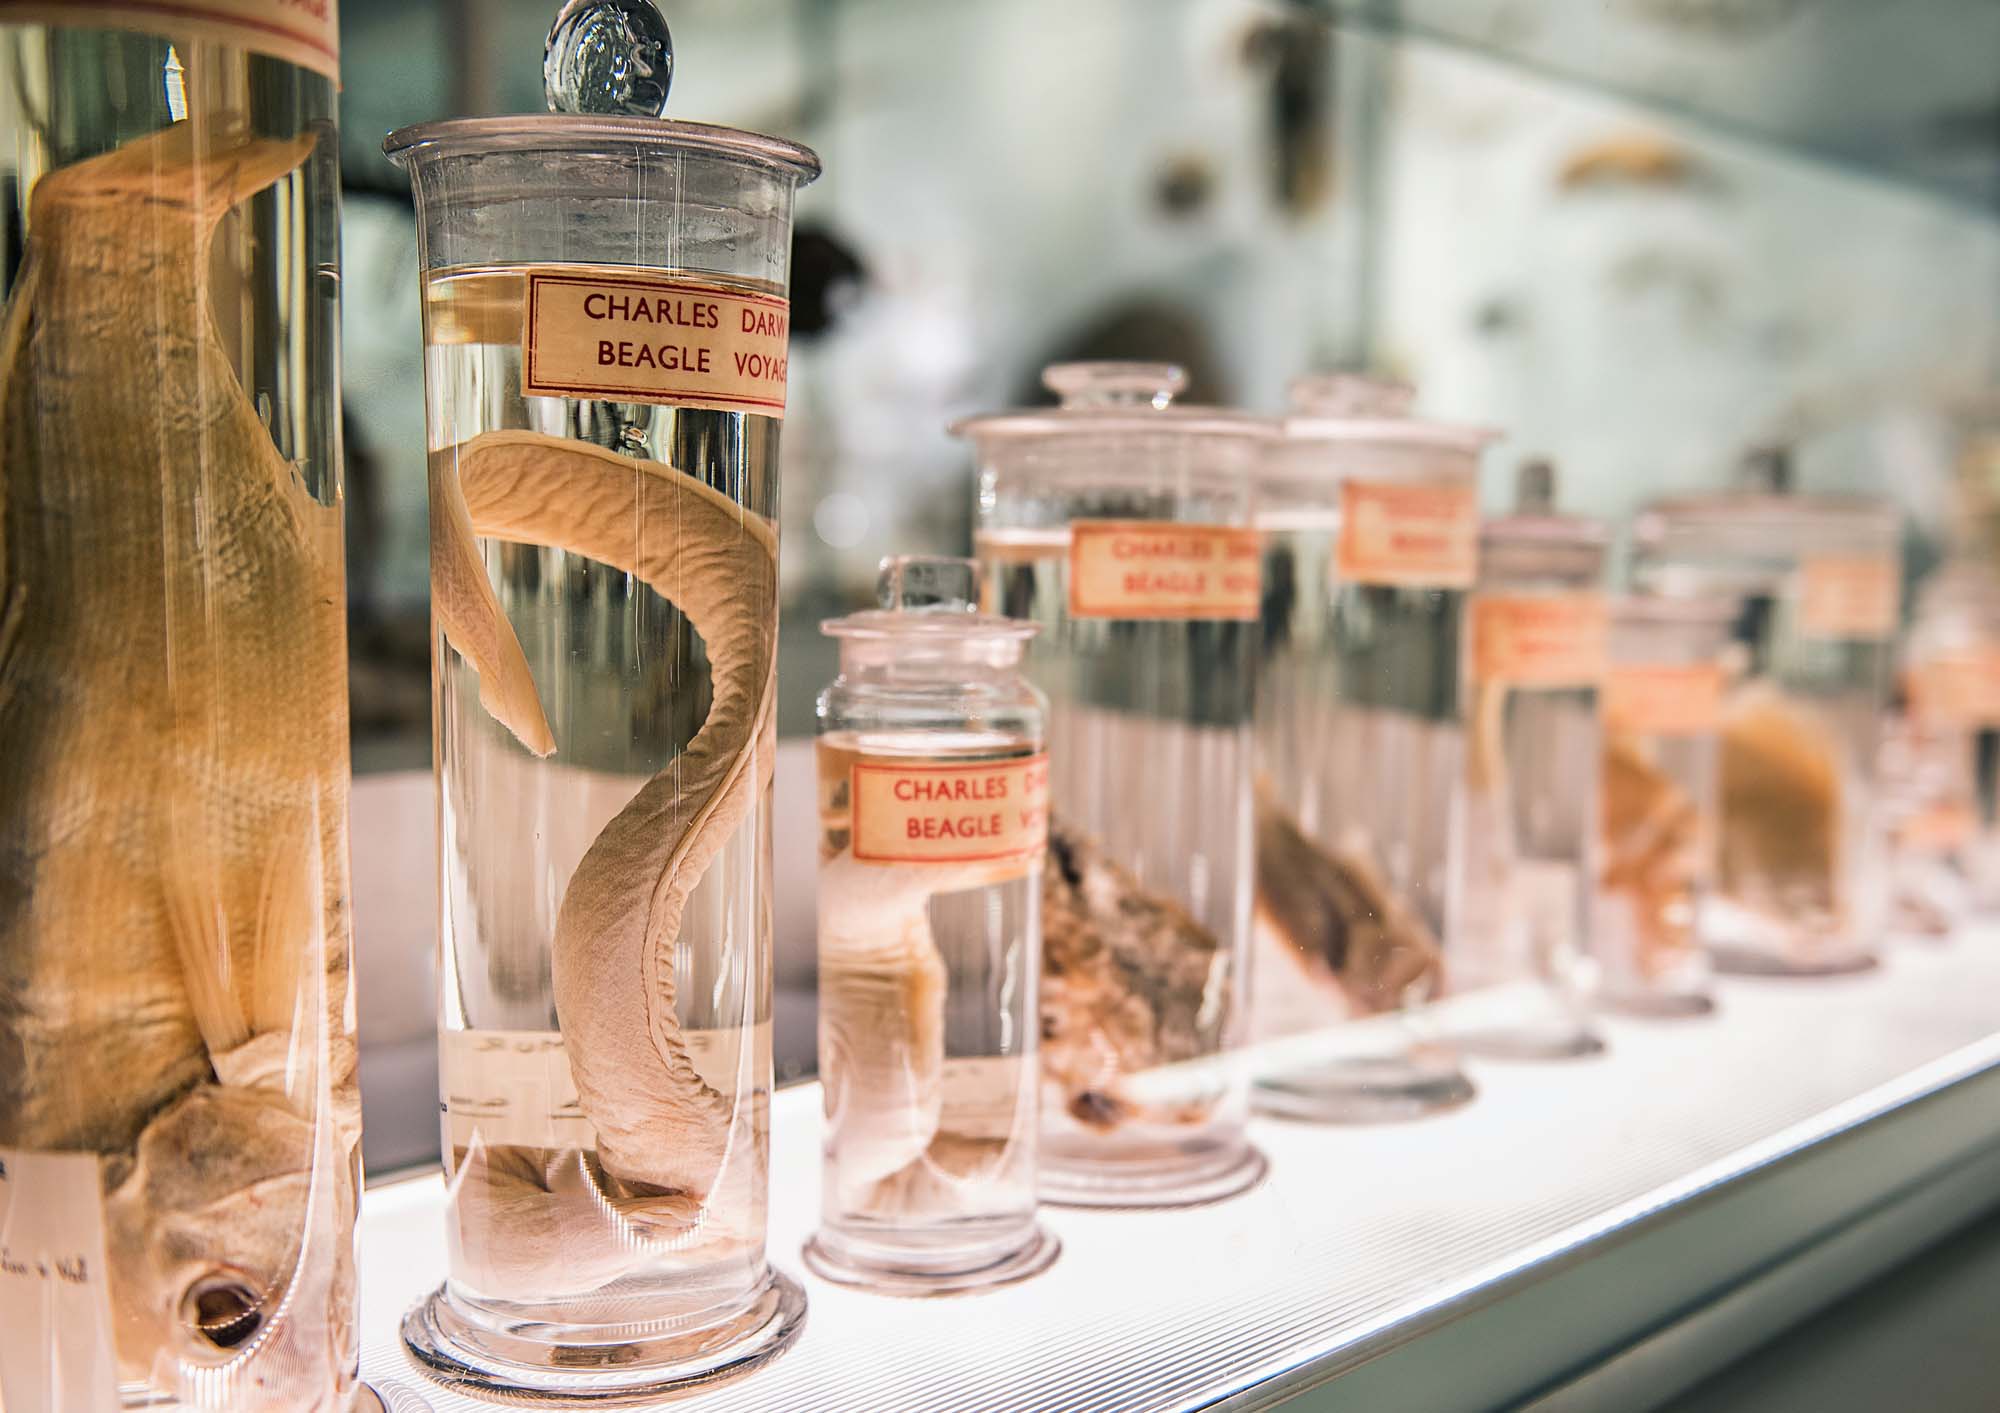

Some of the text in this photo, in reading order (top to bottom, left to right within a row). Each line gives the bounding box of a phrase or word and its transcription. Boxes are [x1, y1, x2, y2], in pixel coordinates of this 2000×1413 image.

[583, 293, 719, 329] CHARLES
[598, 340, 788, 384] BEAGLE VOYAG
[893, 774, 1008, 801] CHARLES
[906, 813, 1003, 840] BEAGLE
